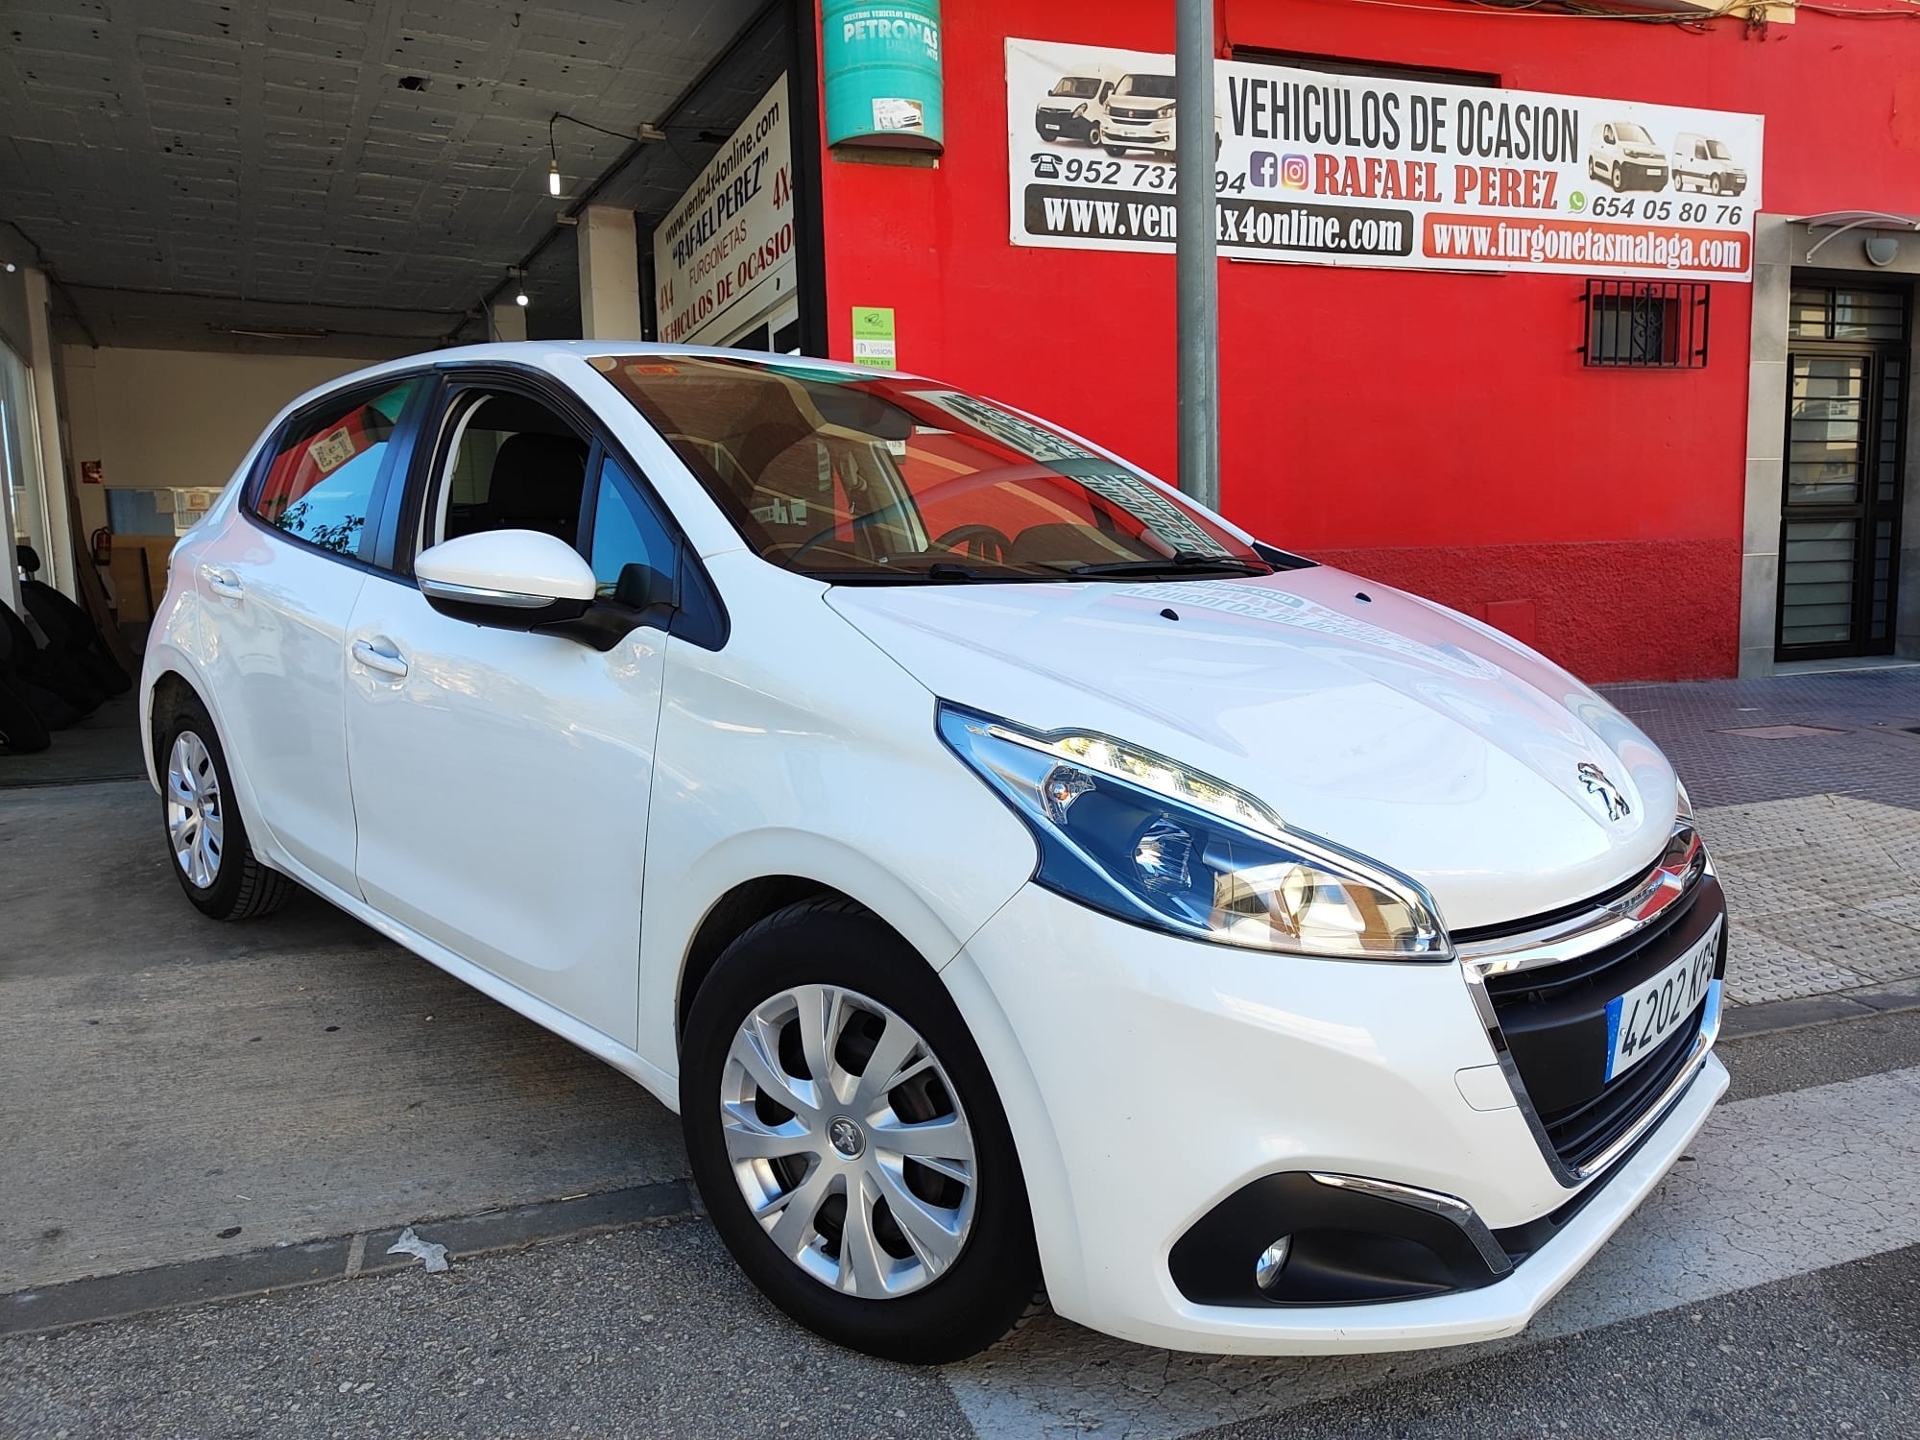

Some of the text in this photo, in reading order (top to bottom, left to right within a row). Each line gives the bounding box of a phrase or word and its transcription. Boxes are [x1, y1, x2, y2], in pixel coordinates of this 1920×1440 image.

[843, 19, 938, 50] PETRONAS
[1229, 77, 1579, 163] VEHICULOS DE OCASION
[1064, 158, 1122, 185] 952
[1313, 153, 1558, 210] RAFAEL PEREZ
[1043, 197, 1403, 251] www.ven4x4online.com
[1591, 196, 1743, 226] 654 05 80 76
[689, 218, 748, 289] FURGONETAS
[1432, 222, 1741, 270] www.furgonetasmalaga.com
[660, 277, 674, 315] 4X4
[660, 288, 714, 343] VEHICULOS
[717, 271, 734, 306] DE
[1621, 967, 1687, 1057] 4202
